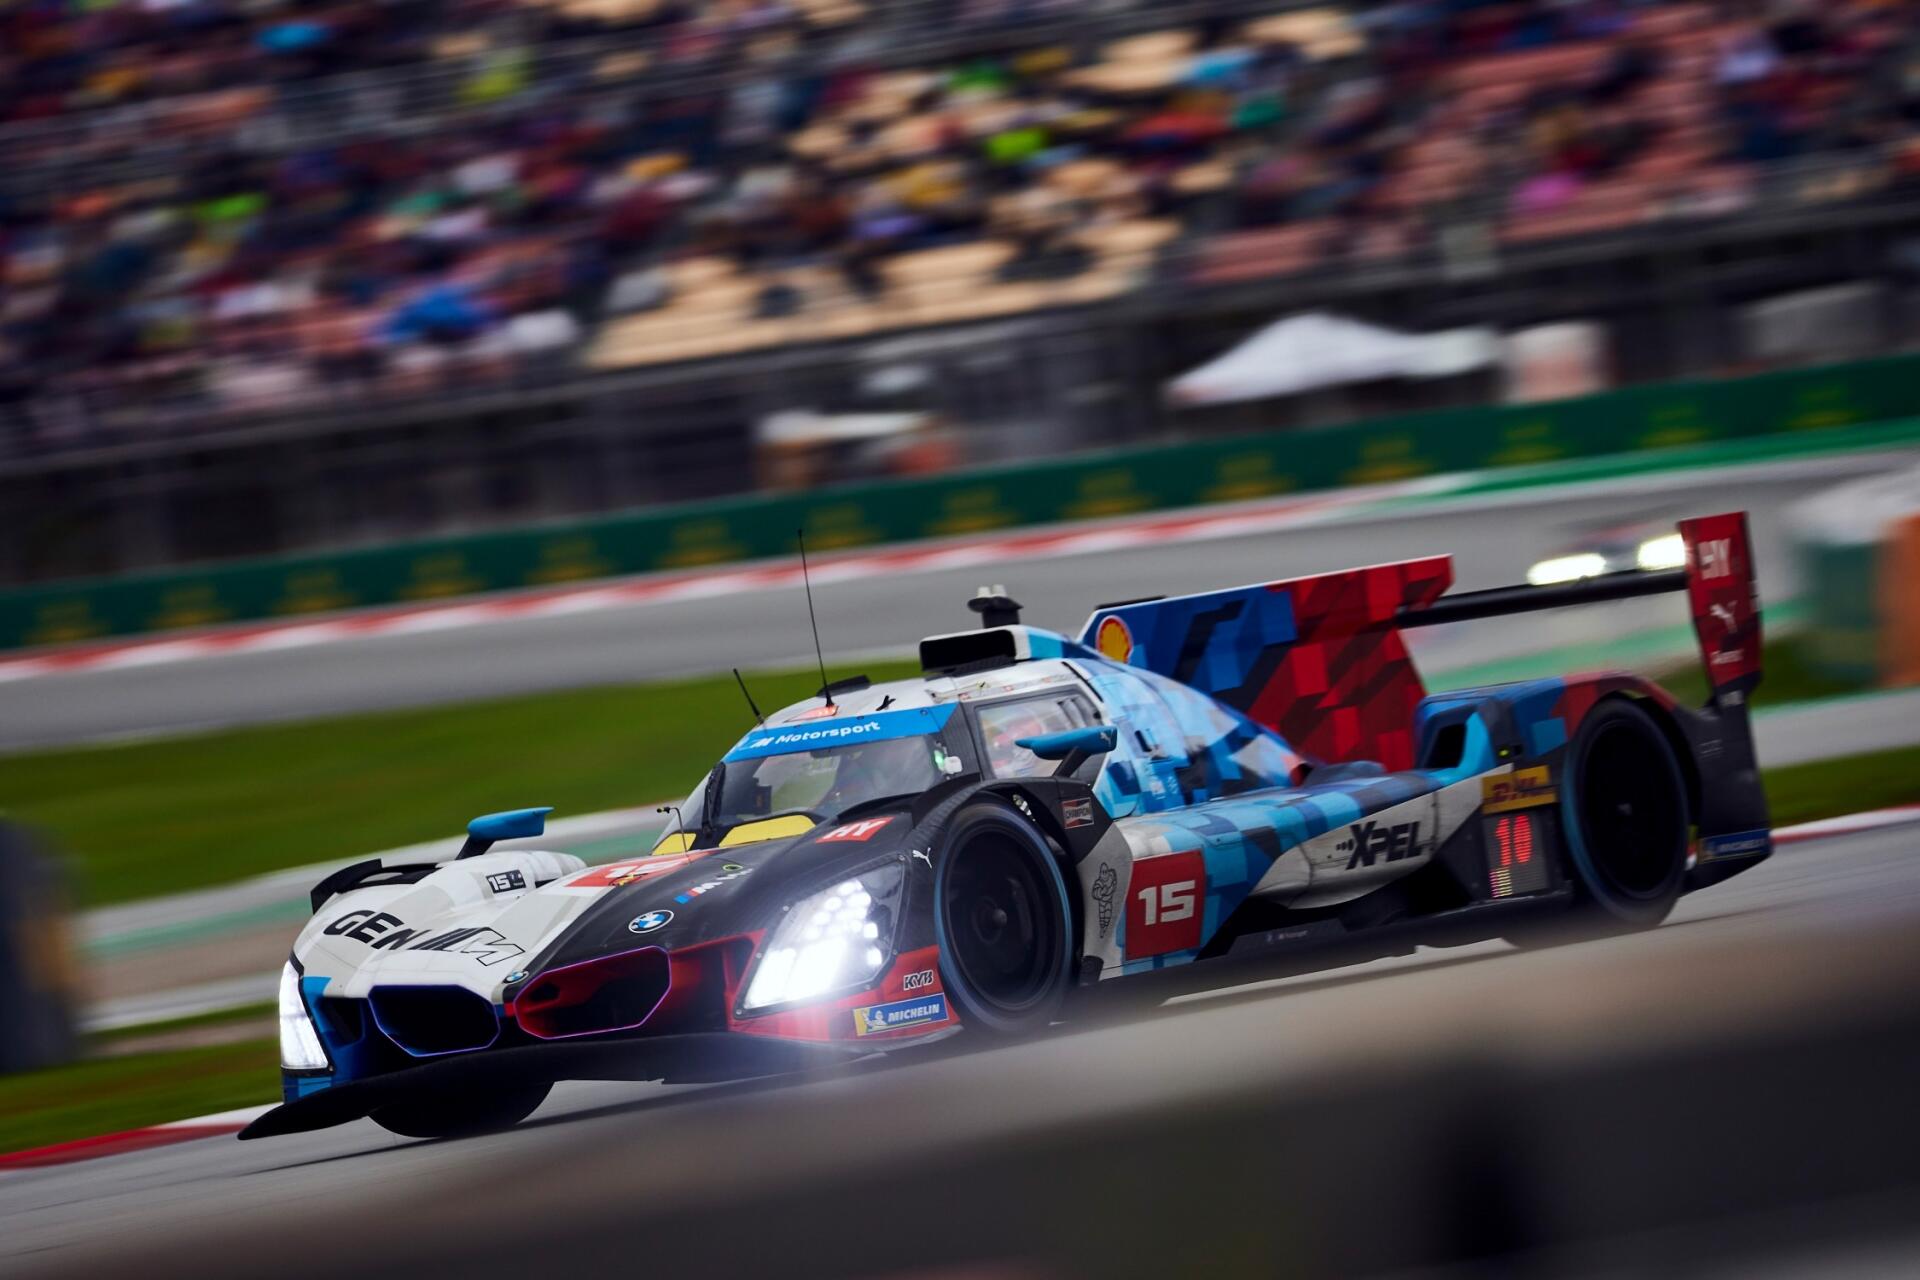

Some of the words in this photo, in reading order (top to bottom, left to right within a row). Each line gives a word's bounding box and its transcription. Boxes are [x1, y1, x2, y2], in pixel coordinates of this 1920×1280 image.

[775, 721, 881, 745] Motorsport
[822, 820, 886, 839] HY
[1345, 821, 1423, 870] XPEL
[487, 873, 511, 891] 15
[1138, 880, 1196, 926] 15
[903, 970, 933, 991] KYB
[887, 1003, 941, 1023] MICHELIN
